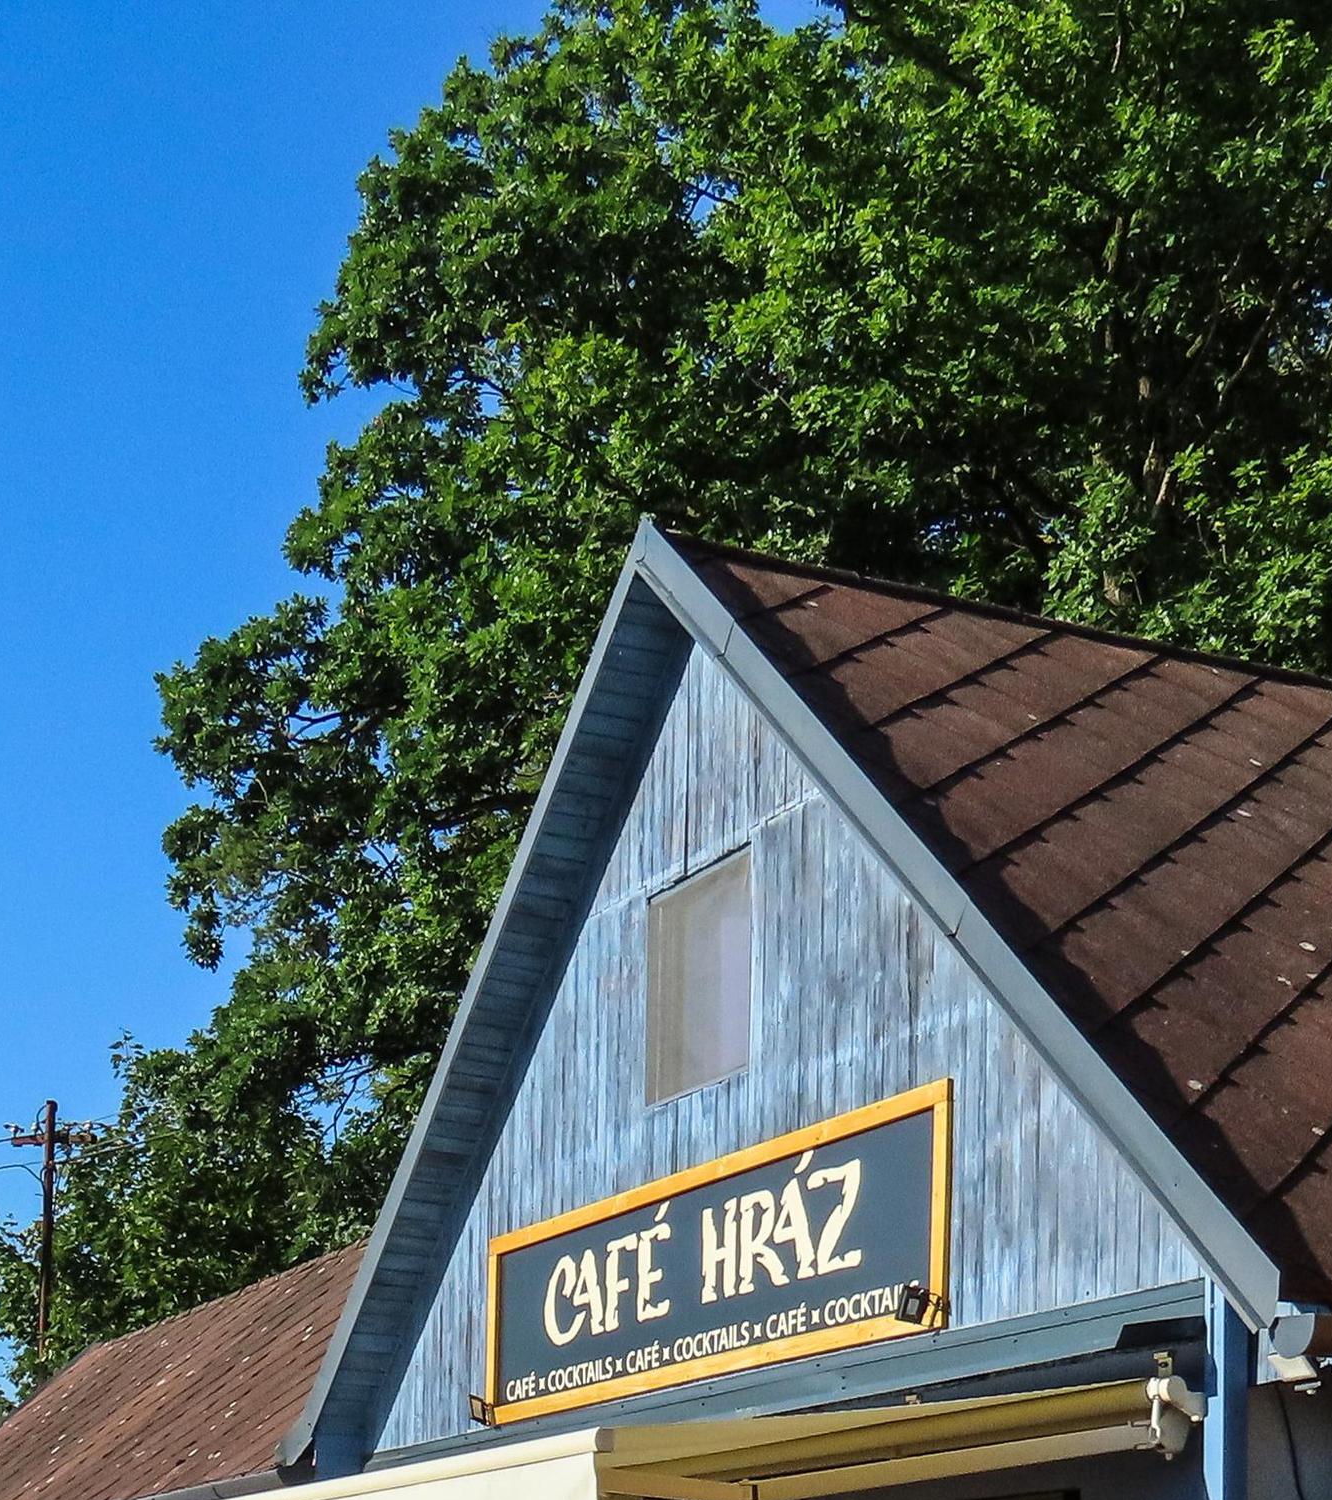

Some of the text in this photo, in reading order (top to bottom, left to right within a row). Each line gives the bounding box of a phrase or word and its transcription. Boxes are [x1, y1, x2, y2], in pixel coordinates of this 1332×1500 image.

[544, 1151, 862, 1346] CAFÉ HRÁZ
[506, 1280, 919, 1401] CAFÉ COCKTAILS CAFÉ COCKTAILS CAFÉ COCKTAI
